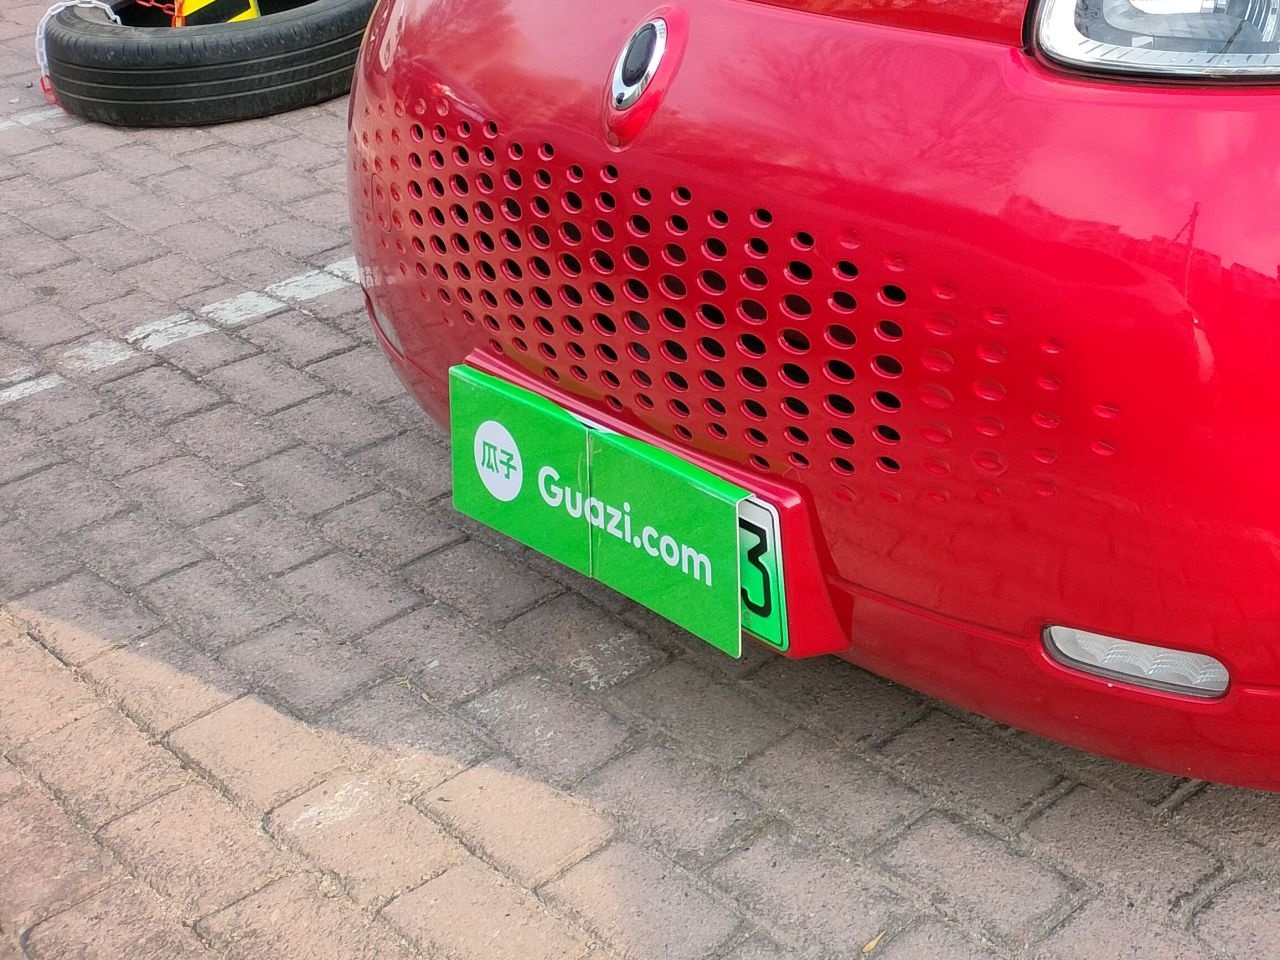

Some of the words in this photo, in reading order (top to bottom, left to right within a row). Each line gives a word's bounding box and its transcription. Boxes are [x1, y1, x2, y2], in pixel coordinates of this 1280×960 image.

[481, 439, 517, 480] 瓜子
[537, 465, 713, 588] Guazi.com
[738, 516, 772, 618] 3
